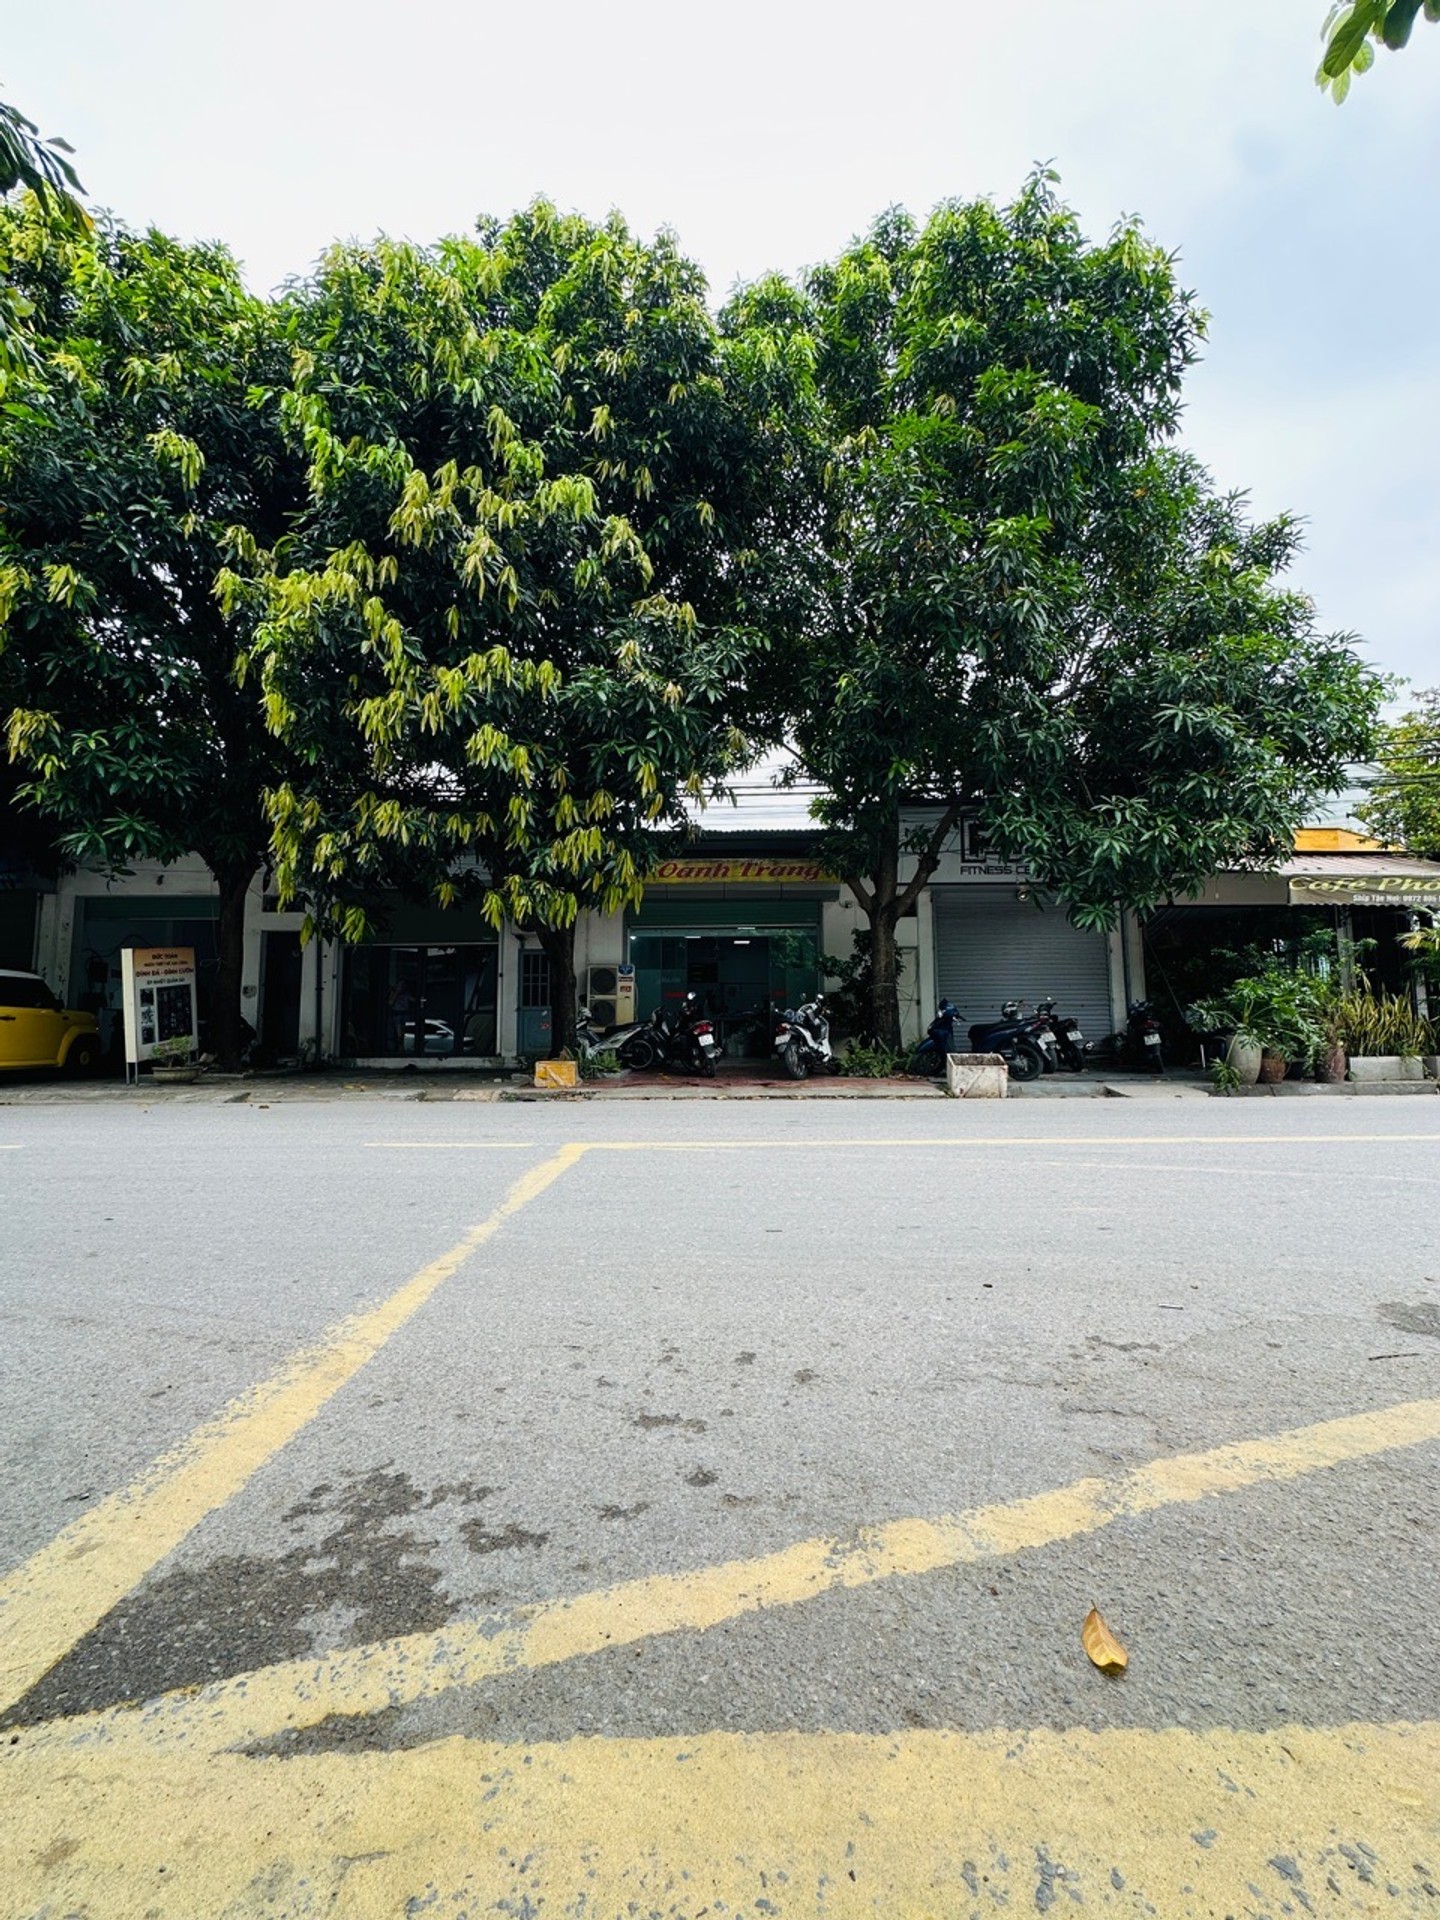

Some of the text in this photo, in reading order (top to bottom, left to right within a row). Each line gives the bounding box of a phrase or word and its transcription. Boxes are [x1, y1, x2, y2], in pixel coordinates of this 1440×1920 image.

[657, 862, 822, 880] Oanh Trang
[960, 865, 1013, 875] FITNESS
